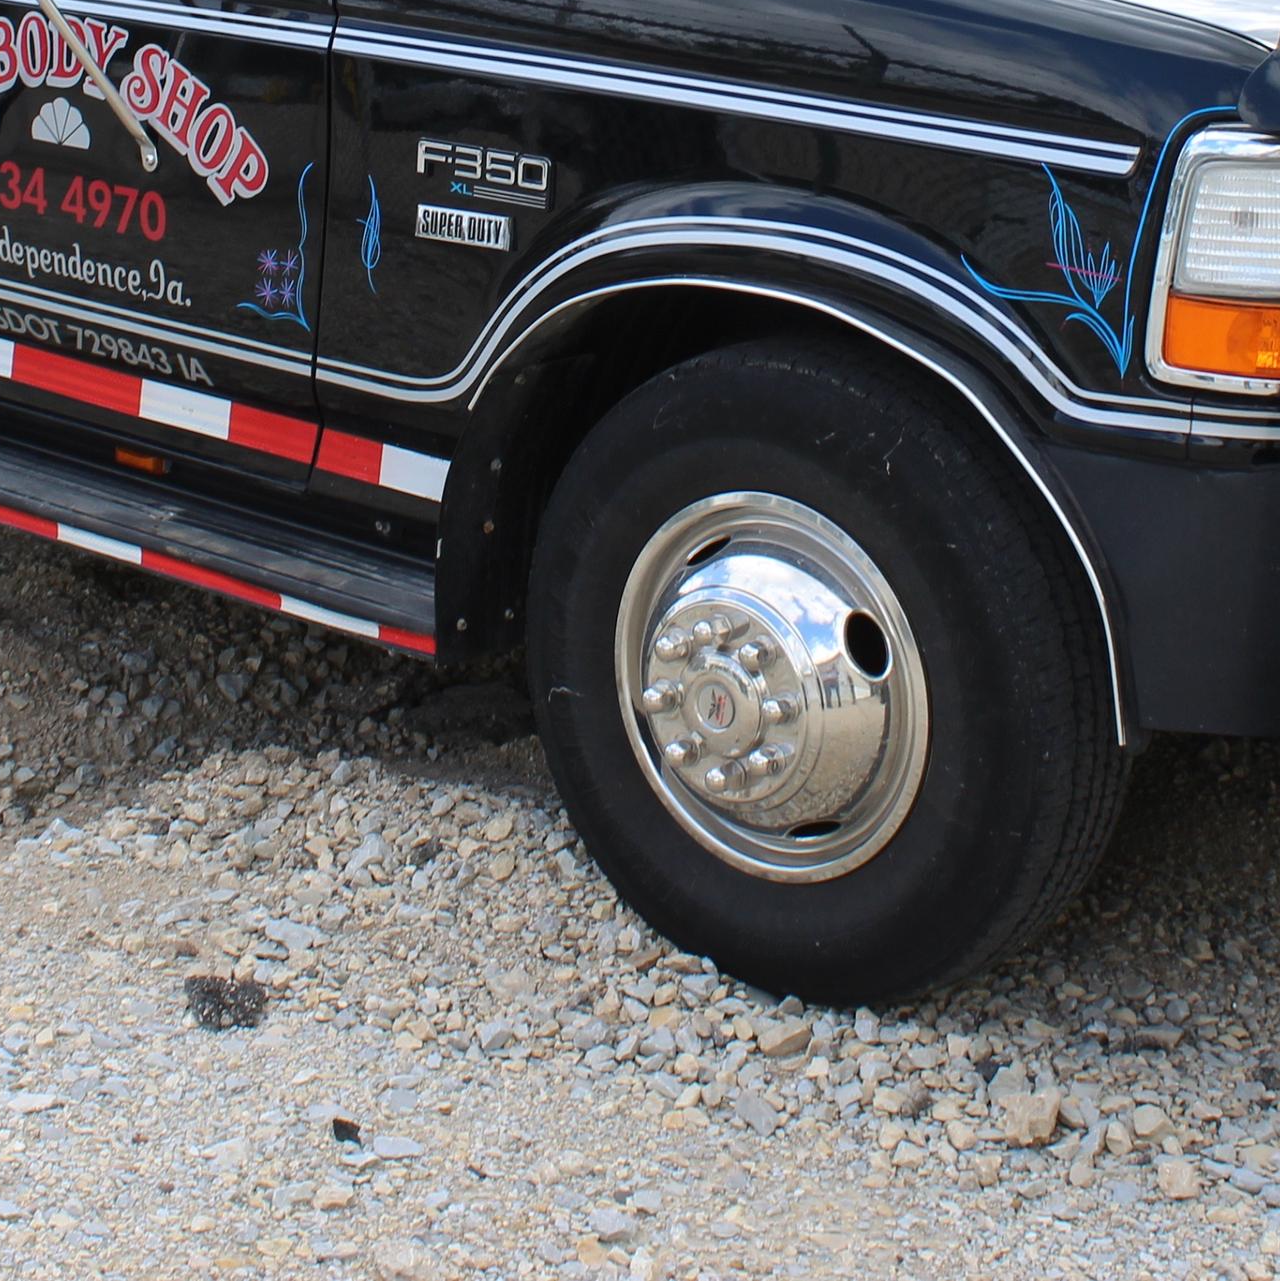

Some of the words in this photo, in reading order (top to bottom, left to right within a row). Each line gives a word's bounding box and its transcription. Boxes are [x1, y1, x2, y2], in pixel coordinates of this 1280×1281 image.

[122, 43, 269, 207] SHOP
[61, 175, 167, 242] 4970
[450, 181, 473, 196] XL
[422, 209, 464, 239] SUPER
[468, 216, 503, 245] DUTY
[67, 324, 172, 375] 729843
[176, 353, 214, 387] IA
